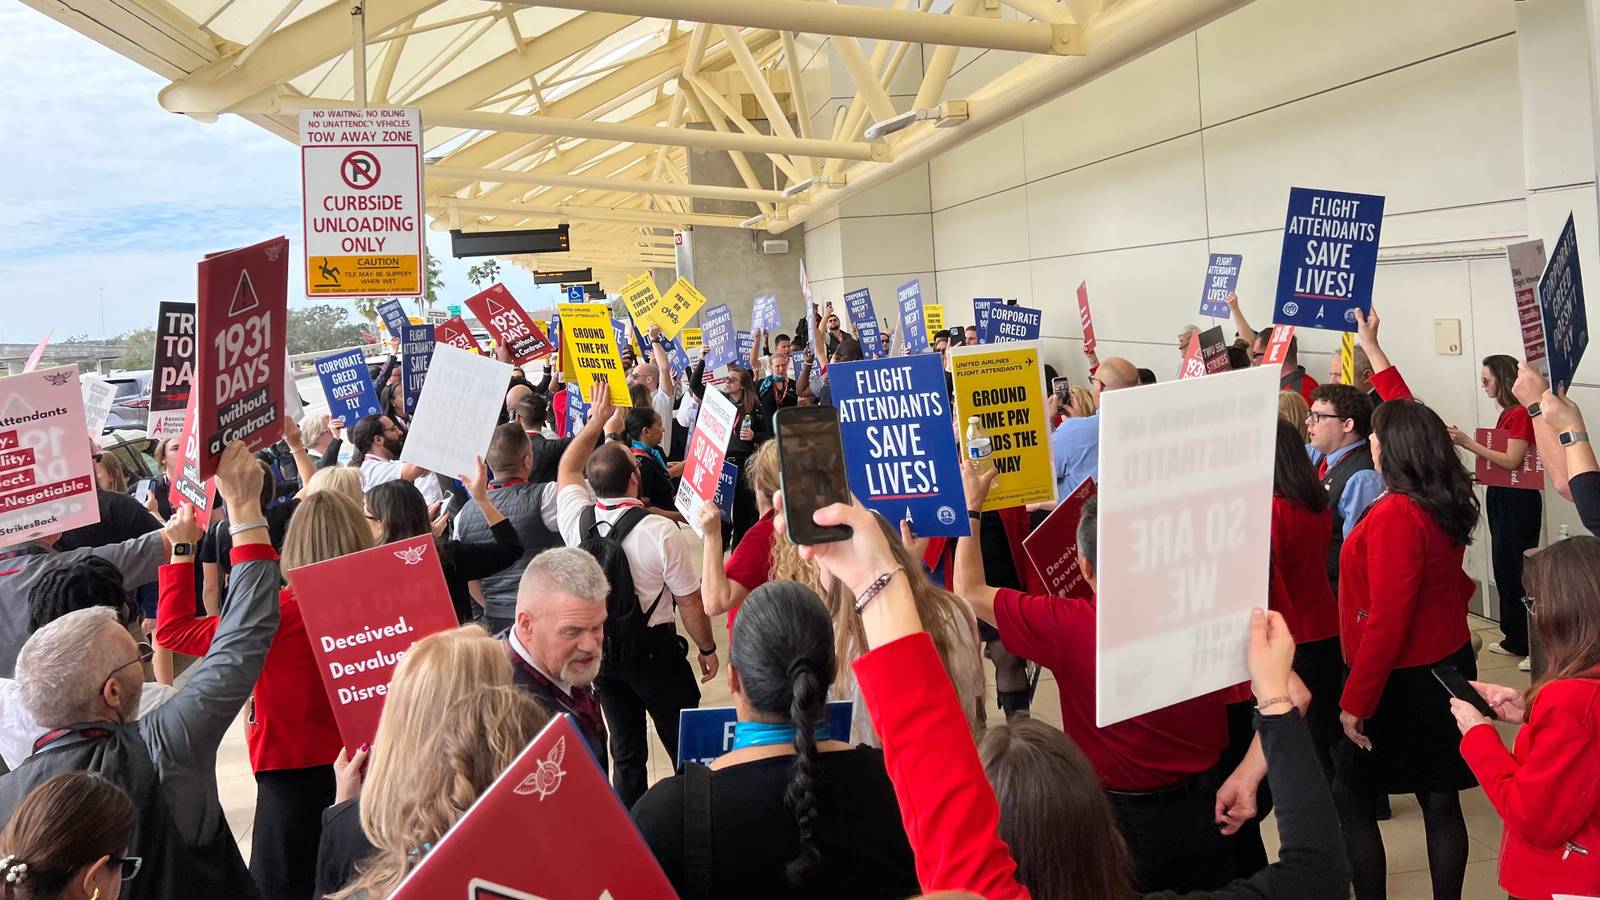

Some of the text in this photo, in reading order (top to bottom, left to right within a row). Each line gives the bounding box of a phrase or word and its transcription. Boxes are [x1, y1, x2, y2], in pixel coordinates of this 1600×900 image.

[307, 131, 412, 142] TOW AWAY ZONE
[324, 195, 403, 211] CURBSIDE
[1311, 197, 1360, 219] FLIGHT
[314, 216, 414, 232] UNLOADING
[1289, 216, 1376, 242] ATTENDANTS
[342, 237, 386, 252] ONLY
[1216, 257, 1232, 266] FLIGHT
[1305, 240, 1353, 269] SAVE
[1208, 266, 1238, 276] ATTENDANTS
[1542, 224, 1575, 309] CORPORATE
[1212, 276, 1228, 288] SAVE
[1295, 267, 1355, 298] LIVES!
[630, 286, 651, 302] GROUND
[846, 290, 868, 302] CORPORATE
[898, 282, 919, 302] CORPORATE
[1208, 289, 1228, 301] LIVES!
[1553, 268, 1571, 318] GREED
[633, 298, 645, 309] TIME
[646, 294, 655, 302] PAY
[673, 303, 682, 311] OR
[675, 293, 691, 309] PAY US
[852, 298, 865, 307] GREED
[852, 304, 868, 314] DOESN'T
[904, 298, 916, 312] GREED
[386, 310, 400, 320] GREED
[635, 306, 650, 318] LEADS
[904, 310, 920, 326] DOESN'T
[991, 308, 1039, 326] CORPORATE
[1554, 284, 1577, 348] DOESN'T
[165, 312, 196, 334] TR
[490, 309, 523, 333] 1931
[702, 312, 731, 331] CORPORATE
[856, 321, 877, 329] CORPORATE
[409, 329, 427, 341] FLIGHT
[501, 323, 530, 343] DAYS
[573, 328, 605, 340] GROUND
[709, 325, 726, 338] GREED
[1000, 323, 1026, 337] GREED
[164, 336, 192, 358] TO
[214, 310, 271, 372] 1931
[404, 341, 434, 355] ATTENDANTS
[512, 336, 536, 350] without
[576, 342, 609, 354] TIME PAY
[708, 333, 729, 347] DOESN'T
[1563, 324, 1574, 360] FLY
[519, 342, 546, 356] Contract
[715, 346, 724, 356] FLY
[1202, 347, 1215, 360] TWU
[318, 354, 363, 374] CORPORATE
[411, 356, 428, 372] SAVE
[578, 357, 617, 369] LEADS THE
[956, 358, 1009, 369] UNITED AIRLINES
[957, 364, 1022, 377] FLIGHT ATTENDANTS
[1206, 354, 1228, 374] STRIKES
[160, 362, 194, 392] pA
[216, 353, 270, 406] DAYS
[332, 369, 357, 384] GREED
[409, 373, 427, 390] LIVE
[592, 372, 608, 384] WAY
[856, 366, 912, 394] FLIGHT
[332, 380, 365, 399] DOESN'T
[972, 386, 1027, 408] GROUND
[219, 389, 268, 426] without
[346, 396, 360, 410] FLY
[840, 392, 943, 423] ATTENDANTS
[1007, 408, 1029, 426] PAY
[211, 443, 220, 454] a
[222, 406, 275, 446] Contract
[866, 424, 925, 459] SAVE
[1013, 430, 1038, 448] THE
[0, 452, 31, 467] lity.
[694, 436, 718, 476] SO ARE
[993, 455, 1021, 474] WAY
[0, 473, 30, 488] ect.
[865, 460, 939, 496] LIVES!
[0, 480, 89, 508] -Negotiable.
[182, 480, 207, 511] Contract
[0, 516, 58, 536] StrikesBack
[1046, 543, 1076, 576] Deceiv
[1052, 556, 1080, 588] Deval
[320, 616, 414, 653] Deceived.
[328, 650, 410, 679] Devalue
